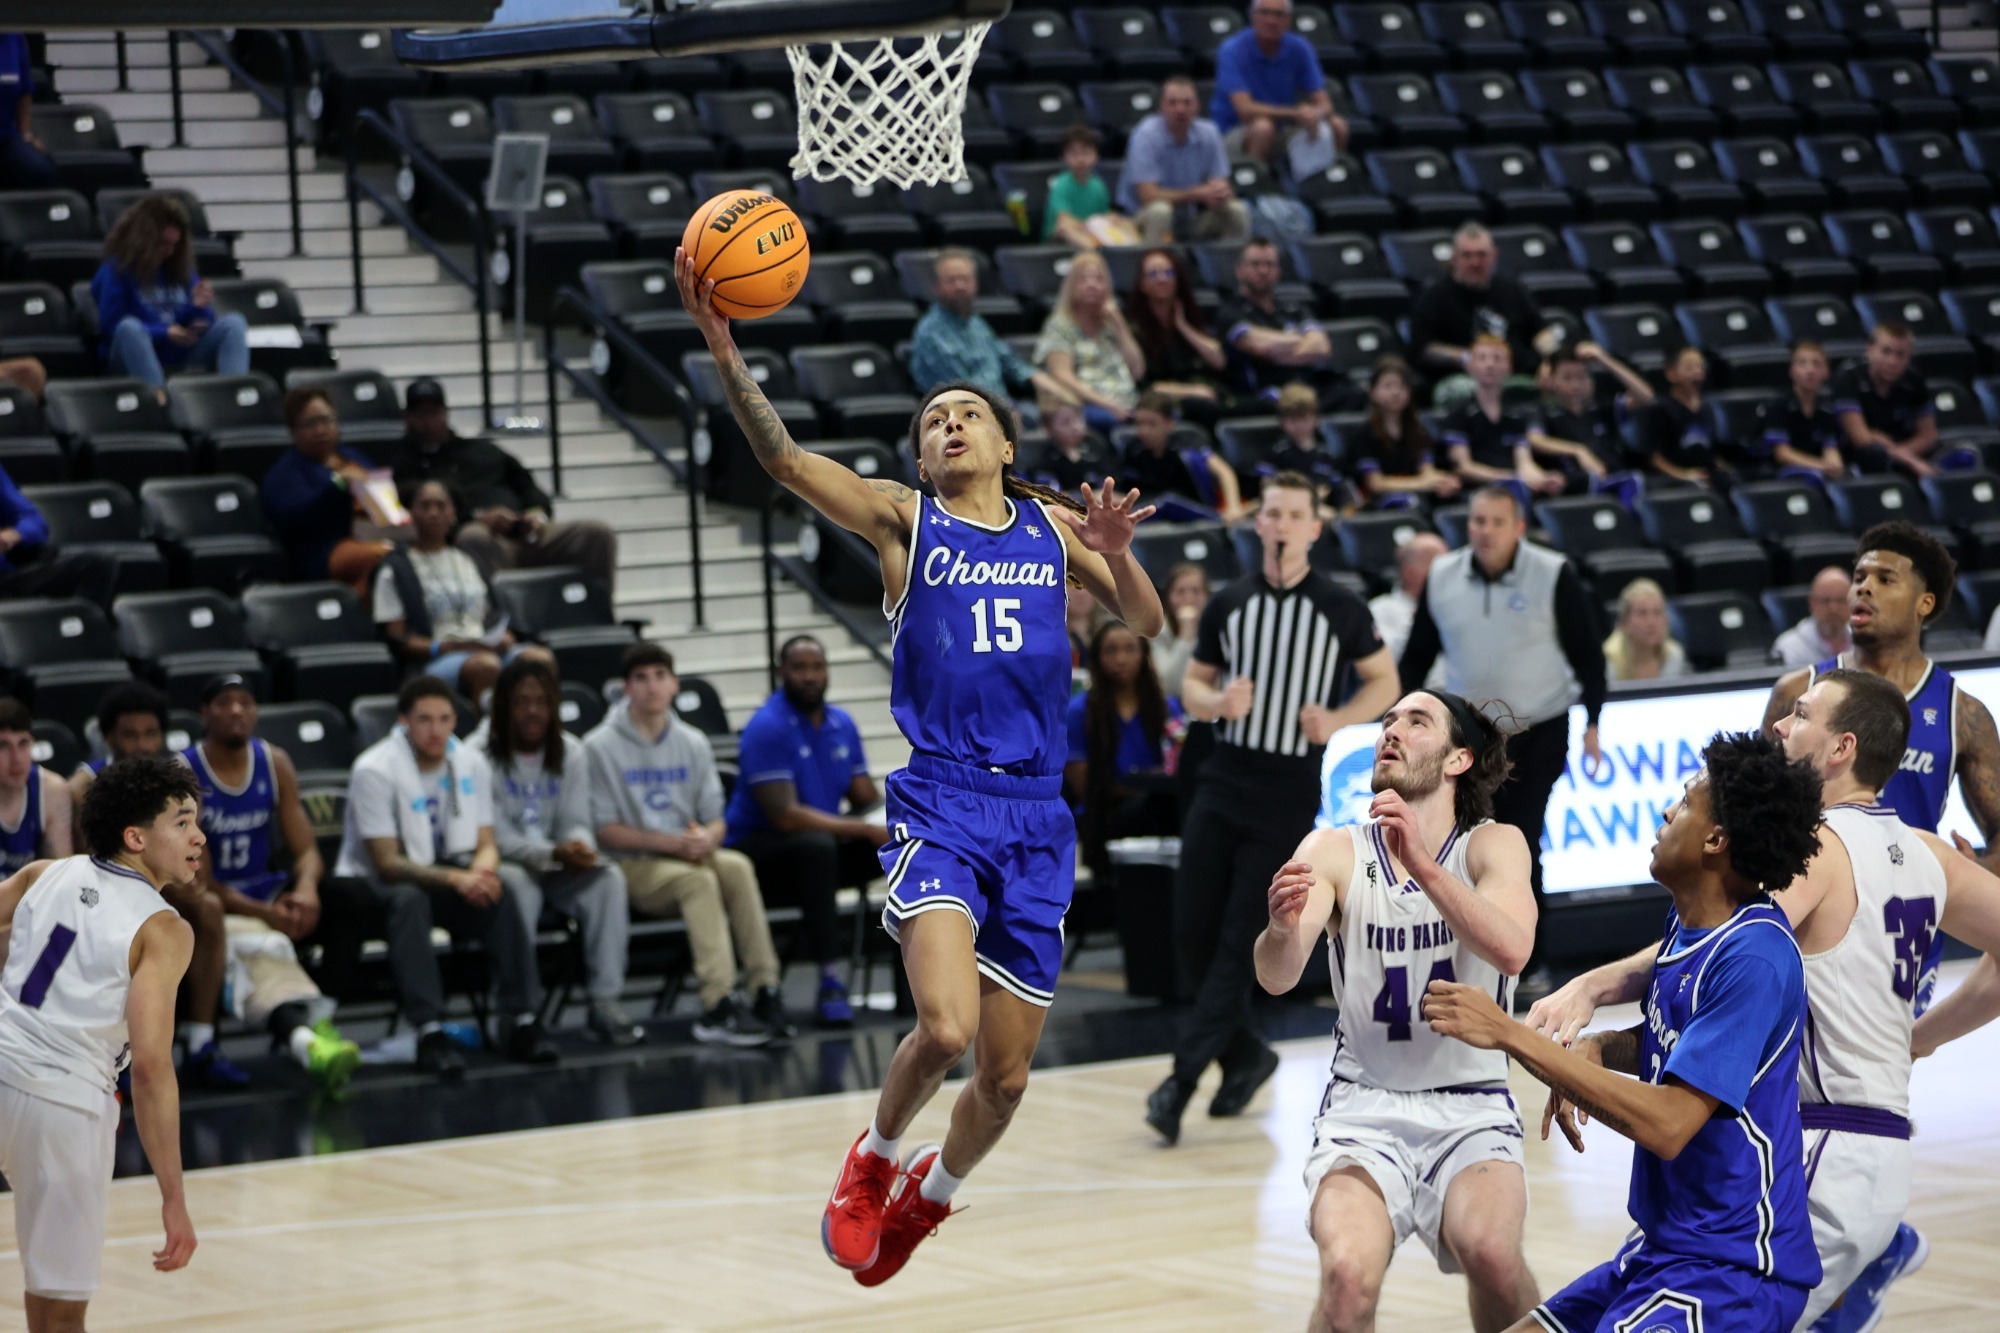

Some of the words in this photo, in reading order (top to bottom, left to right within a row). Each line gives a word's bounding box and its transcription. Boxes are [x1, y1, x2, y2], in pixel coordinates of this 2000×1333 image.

[923, 546, 1058, 587] Chowan
[970, 597, 1024, 653] 15
[220, 835, 250, 870] 13
[19, 921, 78, 1010] 1
